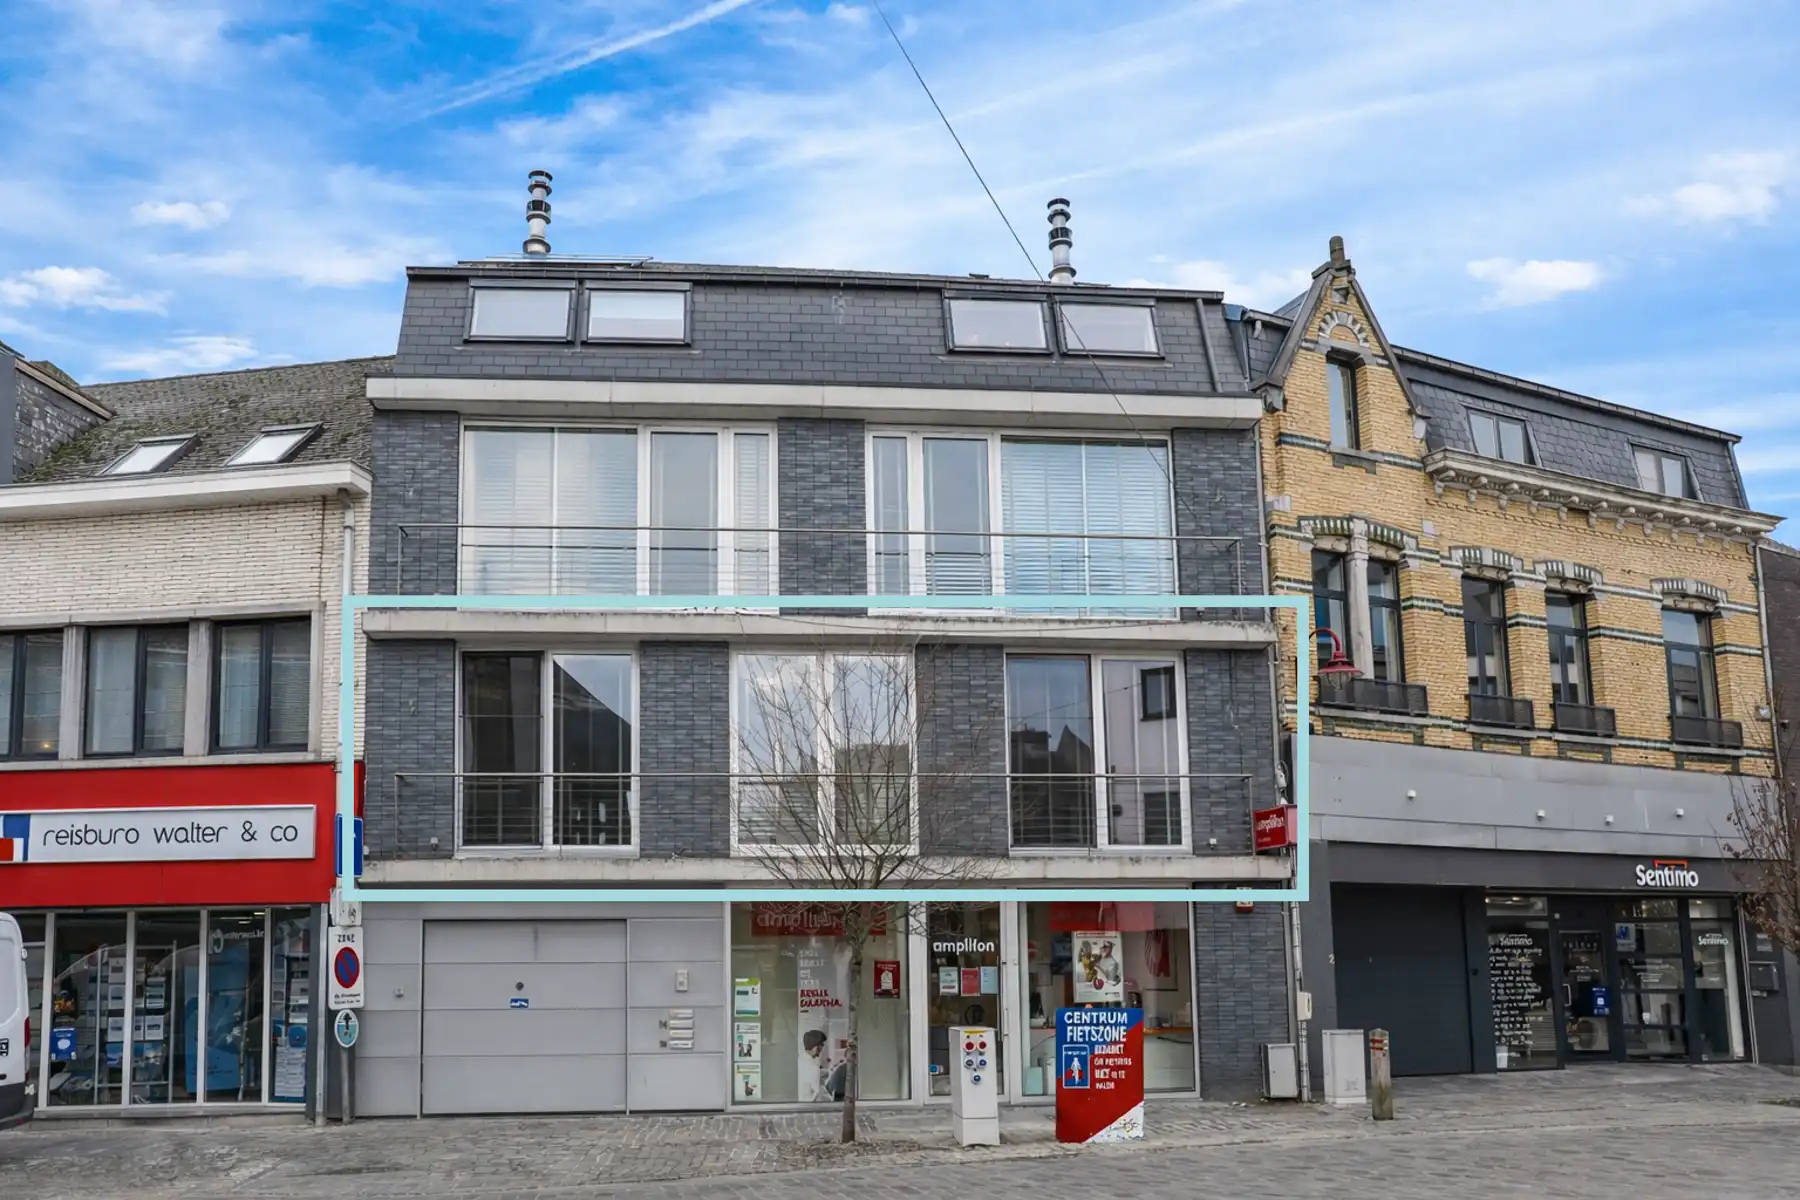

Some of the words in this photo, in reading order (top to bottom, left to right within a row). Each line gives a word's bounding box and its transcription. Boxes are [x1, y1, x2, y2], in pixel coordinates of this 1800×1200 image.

[43, 824, 140, 846] reisburo
[153, 822, 228, 844] walter
[241, 820, 257, 842] &
[270, 824, 299, 842] co
[1635, 864, 1699, 887] Sentimo
[1064, 1011, 1128, 1024] CENTRUM
[1066, 1026, 1127, 1042] FIETSZONE
